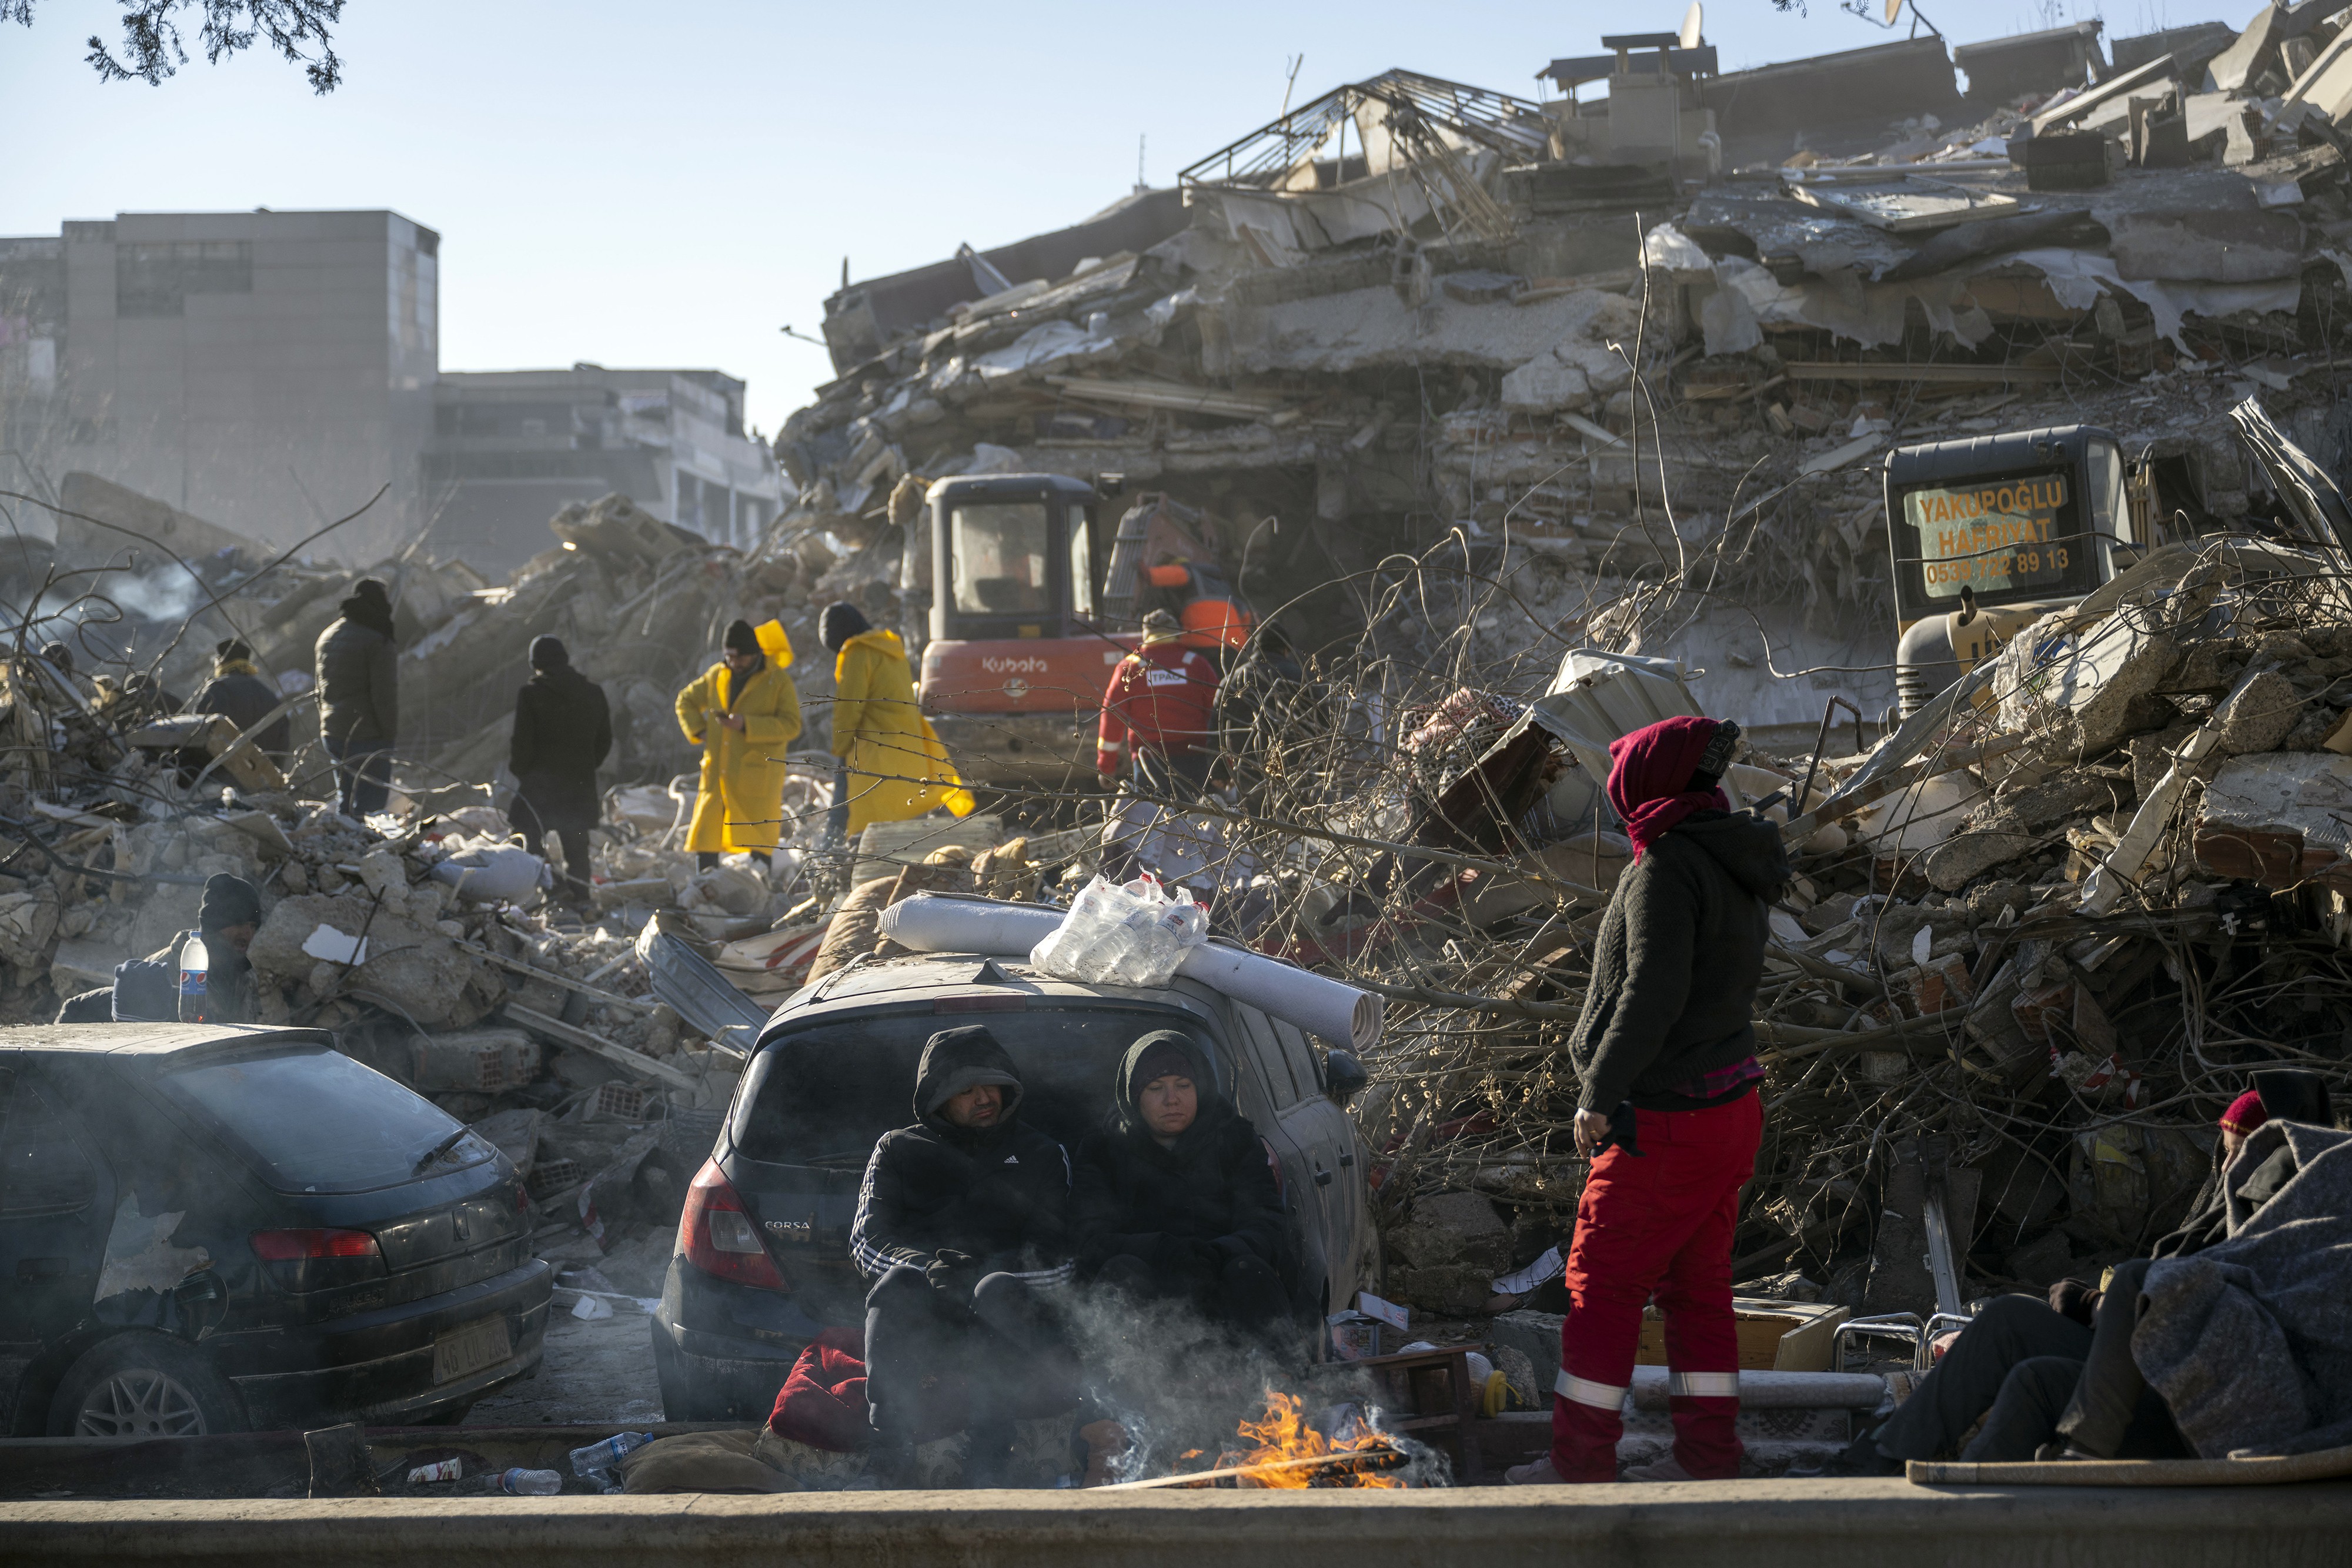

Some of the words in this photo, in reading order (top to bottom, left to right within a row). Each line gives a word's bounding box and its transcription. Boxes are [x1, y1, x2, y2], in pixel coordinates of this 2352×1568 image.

[1920, 479, 2062, 523] YAKUPOĞLU
[1939, 516, 2051, 556] HAFRİYAT
[1927, 561, 1972, 584] 0539
[1977, 555, 2012, 578] 722
[2017, 552, 2039, 573] 89
[2047, 548, 2069, 569] 13
[982, 656, 1047, 673] Kubota
[765, 1221, 810, 1229] CORSA
[442, 1344, 459, 1375] 46
